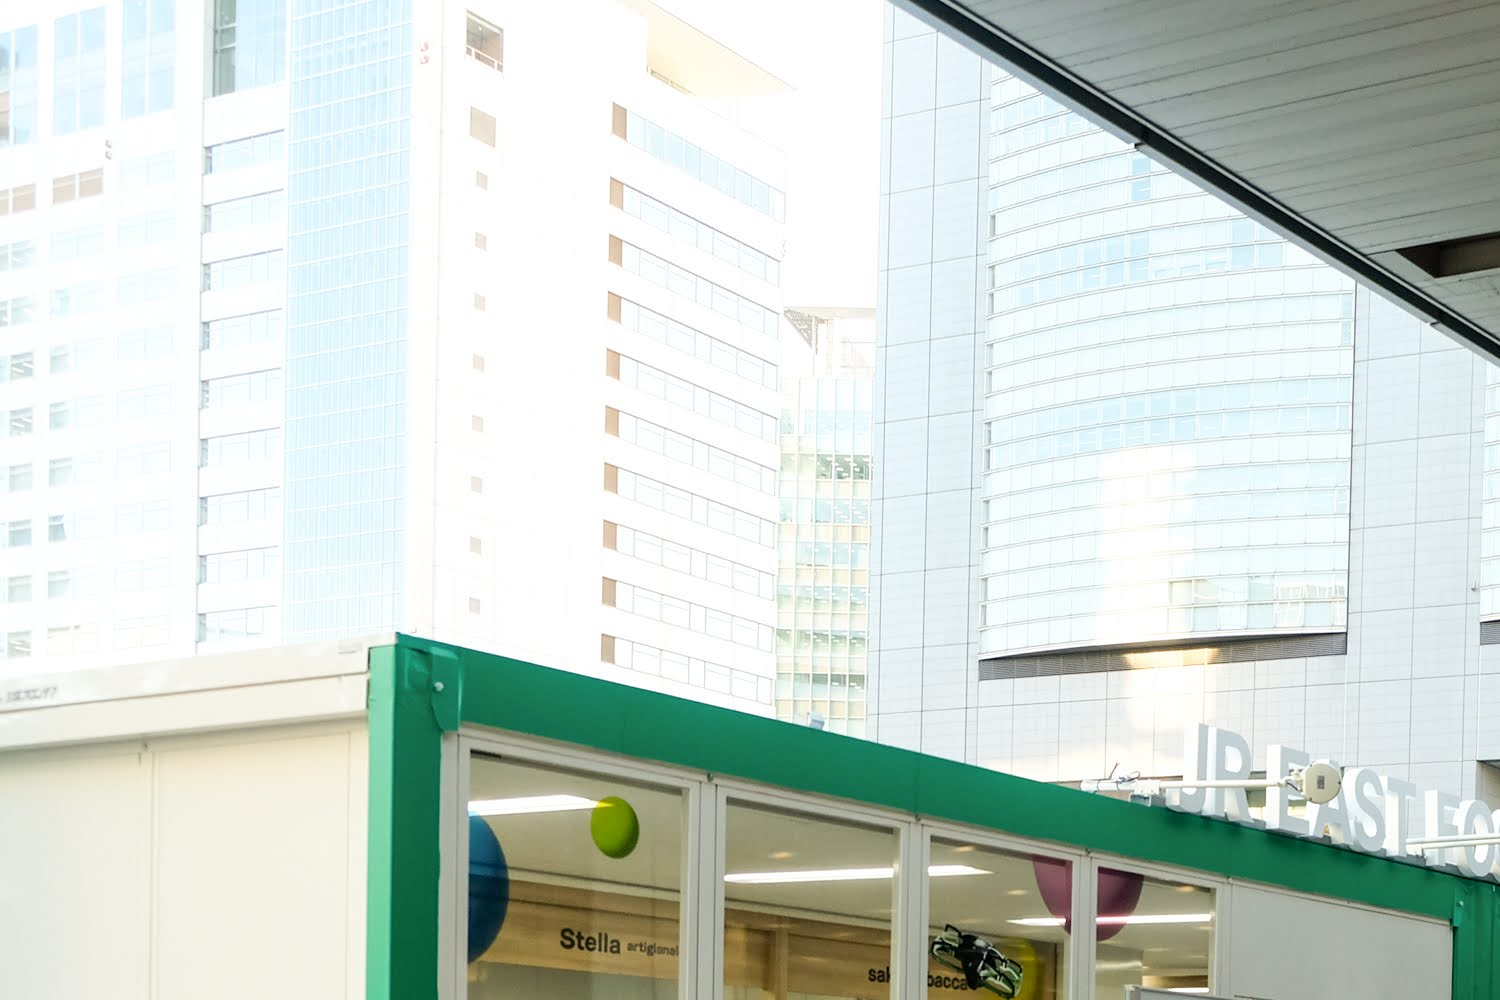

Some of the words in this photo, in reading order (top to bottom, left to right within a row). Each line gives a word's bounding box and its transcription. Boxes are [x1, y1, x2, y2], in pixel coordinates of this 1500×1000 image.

[1166, 722, 1254, 822] JR
[1265, 744, 1416, 858] EAST
[560, 927, 621, 955] Stella
